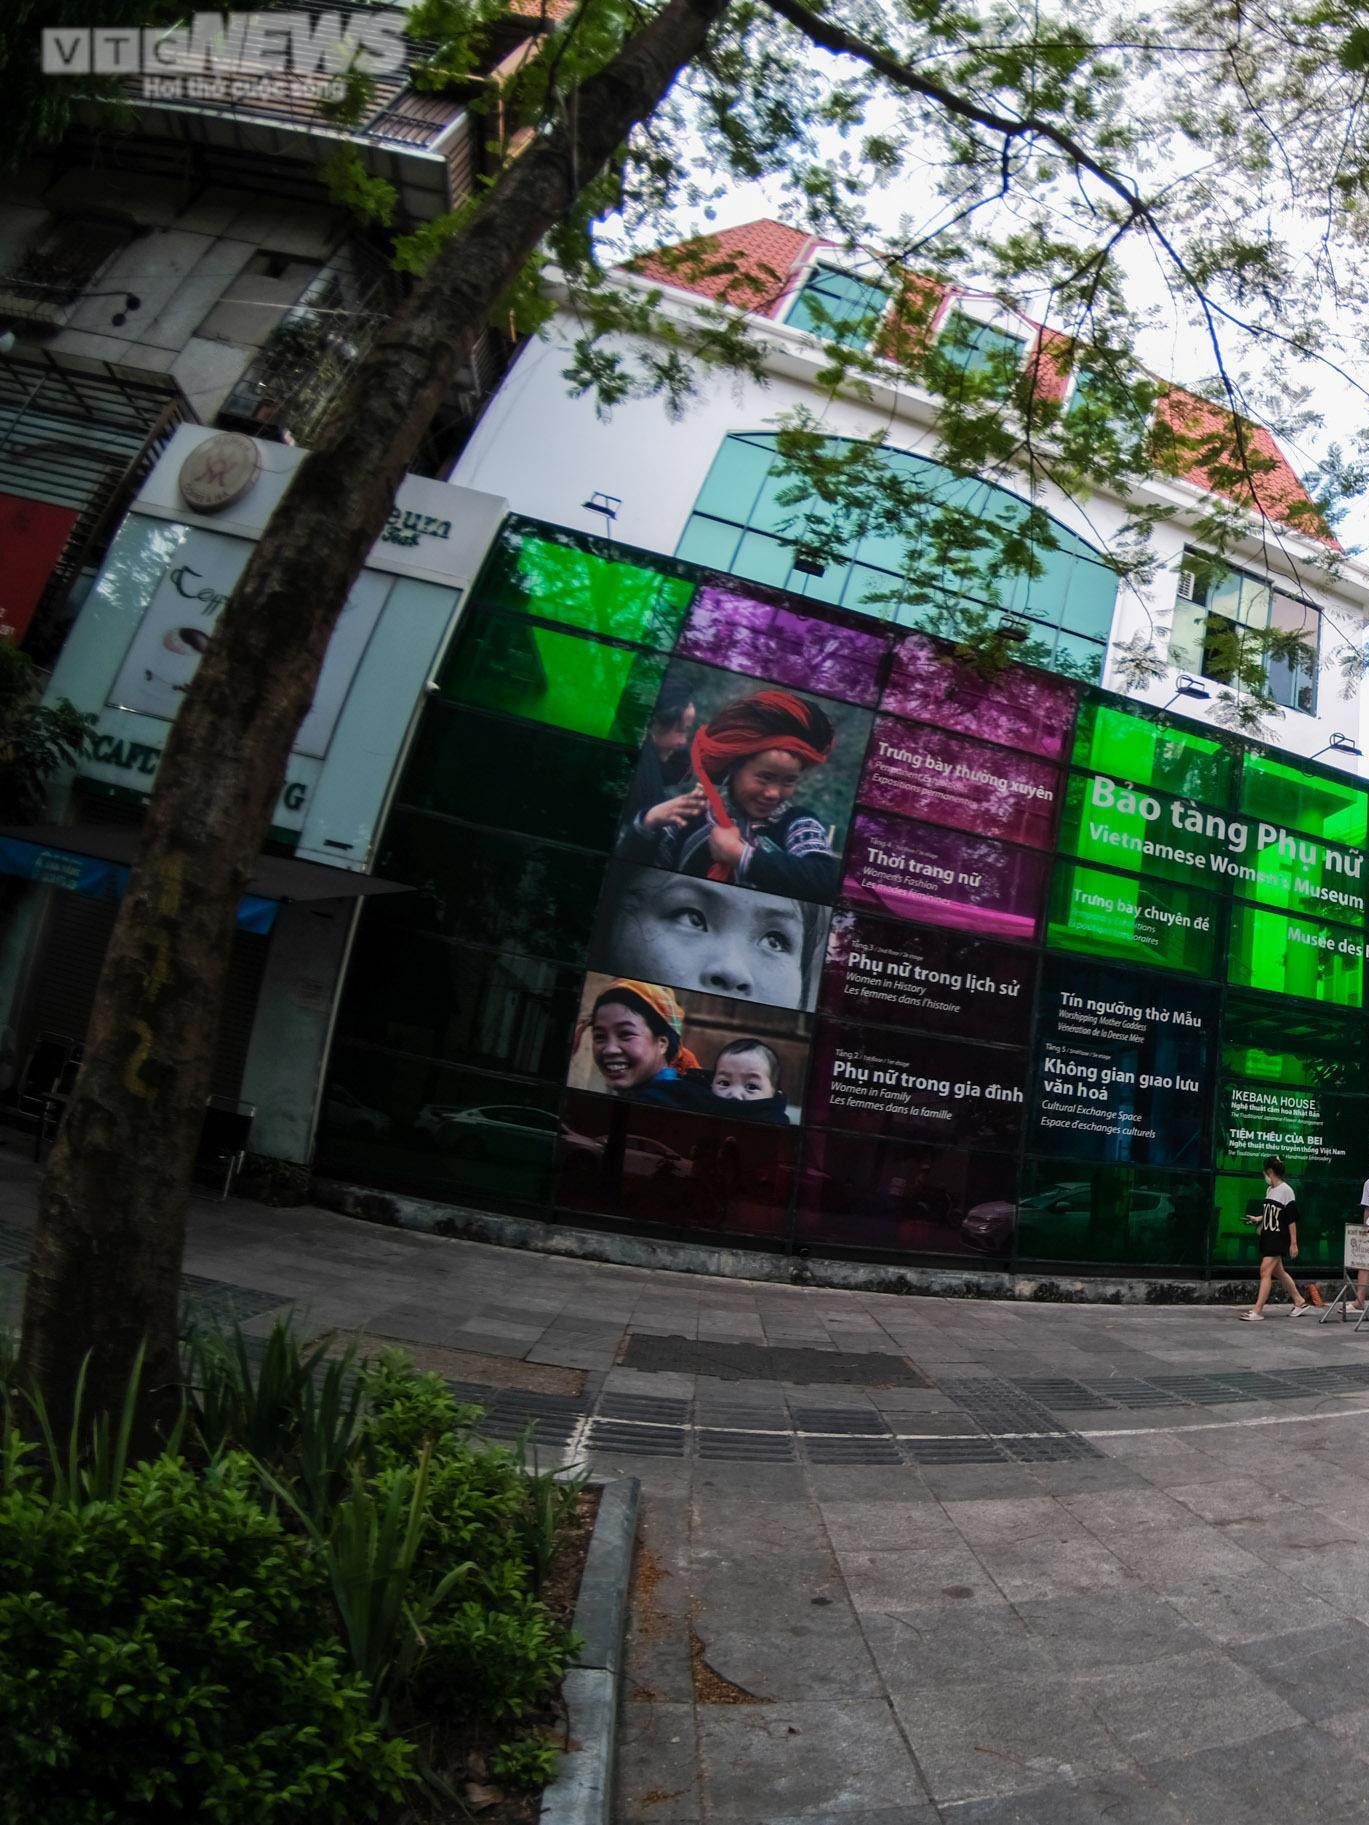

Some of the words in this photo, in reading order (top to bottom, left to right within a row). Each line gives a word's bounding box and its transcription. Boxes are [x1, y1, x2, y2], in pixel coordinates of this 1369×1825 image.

[878, 741, 922, 768] Trưng
[925, 755, 953, 777] bày
[955, 764, 1009, 791] thường
[1010, 778, 1054, 801] xuyên
[872, 773, 921, 794] Expositions
[1091, 775, 1161, 821] Bảo
[1170, 799, 1248, 853] tàng
[1257, 822, 1317, 872] Phụ
[1325, 848, 1363, 879] nữ
[867, 847, 905, 870] Thời
[908, 859, 955, 884] trang
[958, 871, 982, 887] nữ
[1089, 822, 1206, 868] Vietnamese
[1294, 877, 1364, 910] Museum
[861, 878, 876, 889] Les
[863, 866, 903, 883] Women's
[904, 875, 938, 891] Fashion
[1073, 888, 1113, 912] Trưng
[1144, 906, 1191, 927] chuyên
[1338, 938, 1363, 956] des
[846, 972, 882, 987] Women
[883, 978, 892, 988] in
[893, 979, 927, 996] History
[848, 952, 883, 975] Phụ
[887, 962, 912, 978] nữ
[913, 966, 962, 990] trong
[965, 973, 995, 994] lịch
[999, 979, 1021, 997] sử
[844, 984, 859, 995] Les
[860, 986, 897, 1002] femmes
[897, 995, 921, 1007] dans
[921, 998, 961, 1013] l'histoire
[1060, 991, 1083, 1008] Tín
[1087, 999, 1142, 1021] ngưỡng
[1145, 1007, 1170, 1023] thờ
[1172, 1011, 1202, 1028] Mẫu
[1058, 1009, 1098, 1025] Worshipping
[1099, 1016, 1122, 1027] Mother
[1122, 1020, 1147, 1032] Goddess
[1092, 1027, 1101, 1037] de
[1101, 1029, 1107, 1038] la
[832, 1060, 868, 1084] Phụ
[873, 1069, 899, 1085] nữ
[901, 1072, 950, 1096] trong
[953, 1081, 981, 1099] gia
[984, 1083, 1024, 1103] đình
[1044, 1057, 1098, 1082] Không
[1101, 1066, 1135, 1084] gian
[1139, 1074, 1172, 1089] giao
[1175, 1075, 1199, 1092] lưu
[830, 1081, 867, 1096] Women
[868, 1087, 878, 1098] in
[879, 1088, 911, 1104] Family
[1043, 1078, 1073, 1095] văn
[1077, 1082, 1108, 1101] hoá
[1232, 1089, 1278, 1106] IKEBANA
[1280, 1096, 1316, 1110] HOUSE
[829, 1094, 845, 1106] Les
[847, 1096, 885, 1112] femmes
[885, 1103, 909, 1115] dans
[910, 1105, 920, 1116] la
[920, 1106, 953, 1120] famille
[1041, 1099, 1076, 1113] Cultural
[1076, 1105, 1117, 1120] Exchange
[1117, 1110, 1142, 1122] Space
[1231, 1102, 1248, 1111] Nghệ
[1281, 1107, 1293, 1115] hoa
[1040, 1116, 1071, 1129] Espace
[1071, 1119, 1121, 1135] d'eschanges
[1122, 1127, 1156, 1139] culturels
[1229, 1127, 1254, 1142] TIỆM
[1256, 1130, 1282, 1143] THÊU
[1285, 1132, 1304, 1144] CỦA
[1307, 1136, 1323, 1146] BEI
[1229, 1140, 1247, 1149] Nghệ
[1332, 1148, 1346, 1156] Nam
